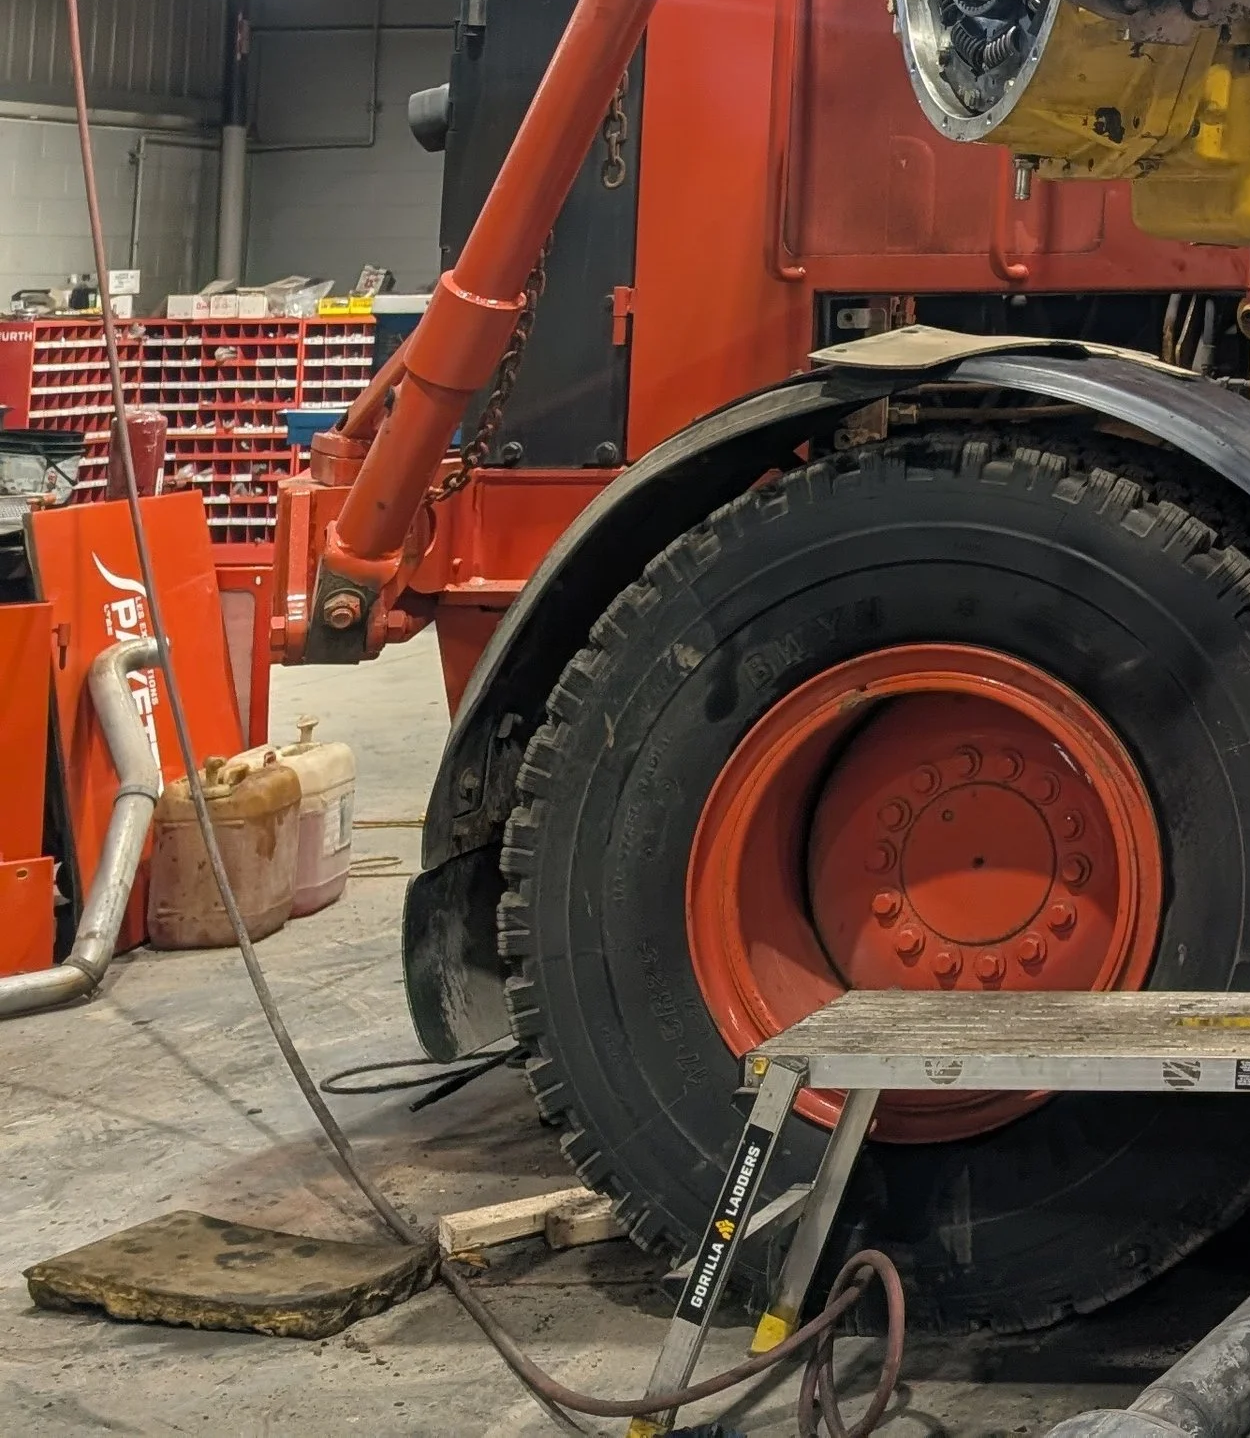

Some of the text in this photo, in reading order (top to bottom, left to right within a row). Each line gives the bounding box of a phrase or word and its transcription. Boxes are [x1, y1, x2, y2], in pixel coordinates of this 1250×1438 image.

[0, 331, 33, 342] URTH
[690, 1144, 761, 1309] GORILLA LADDERS
